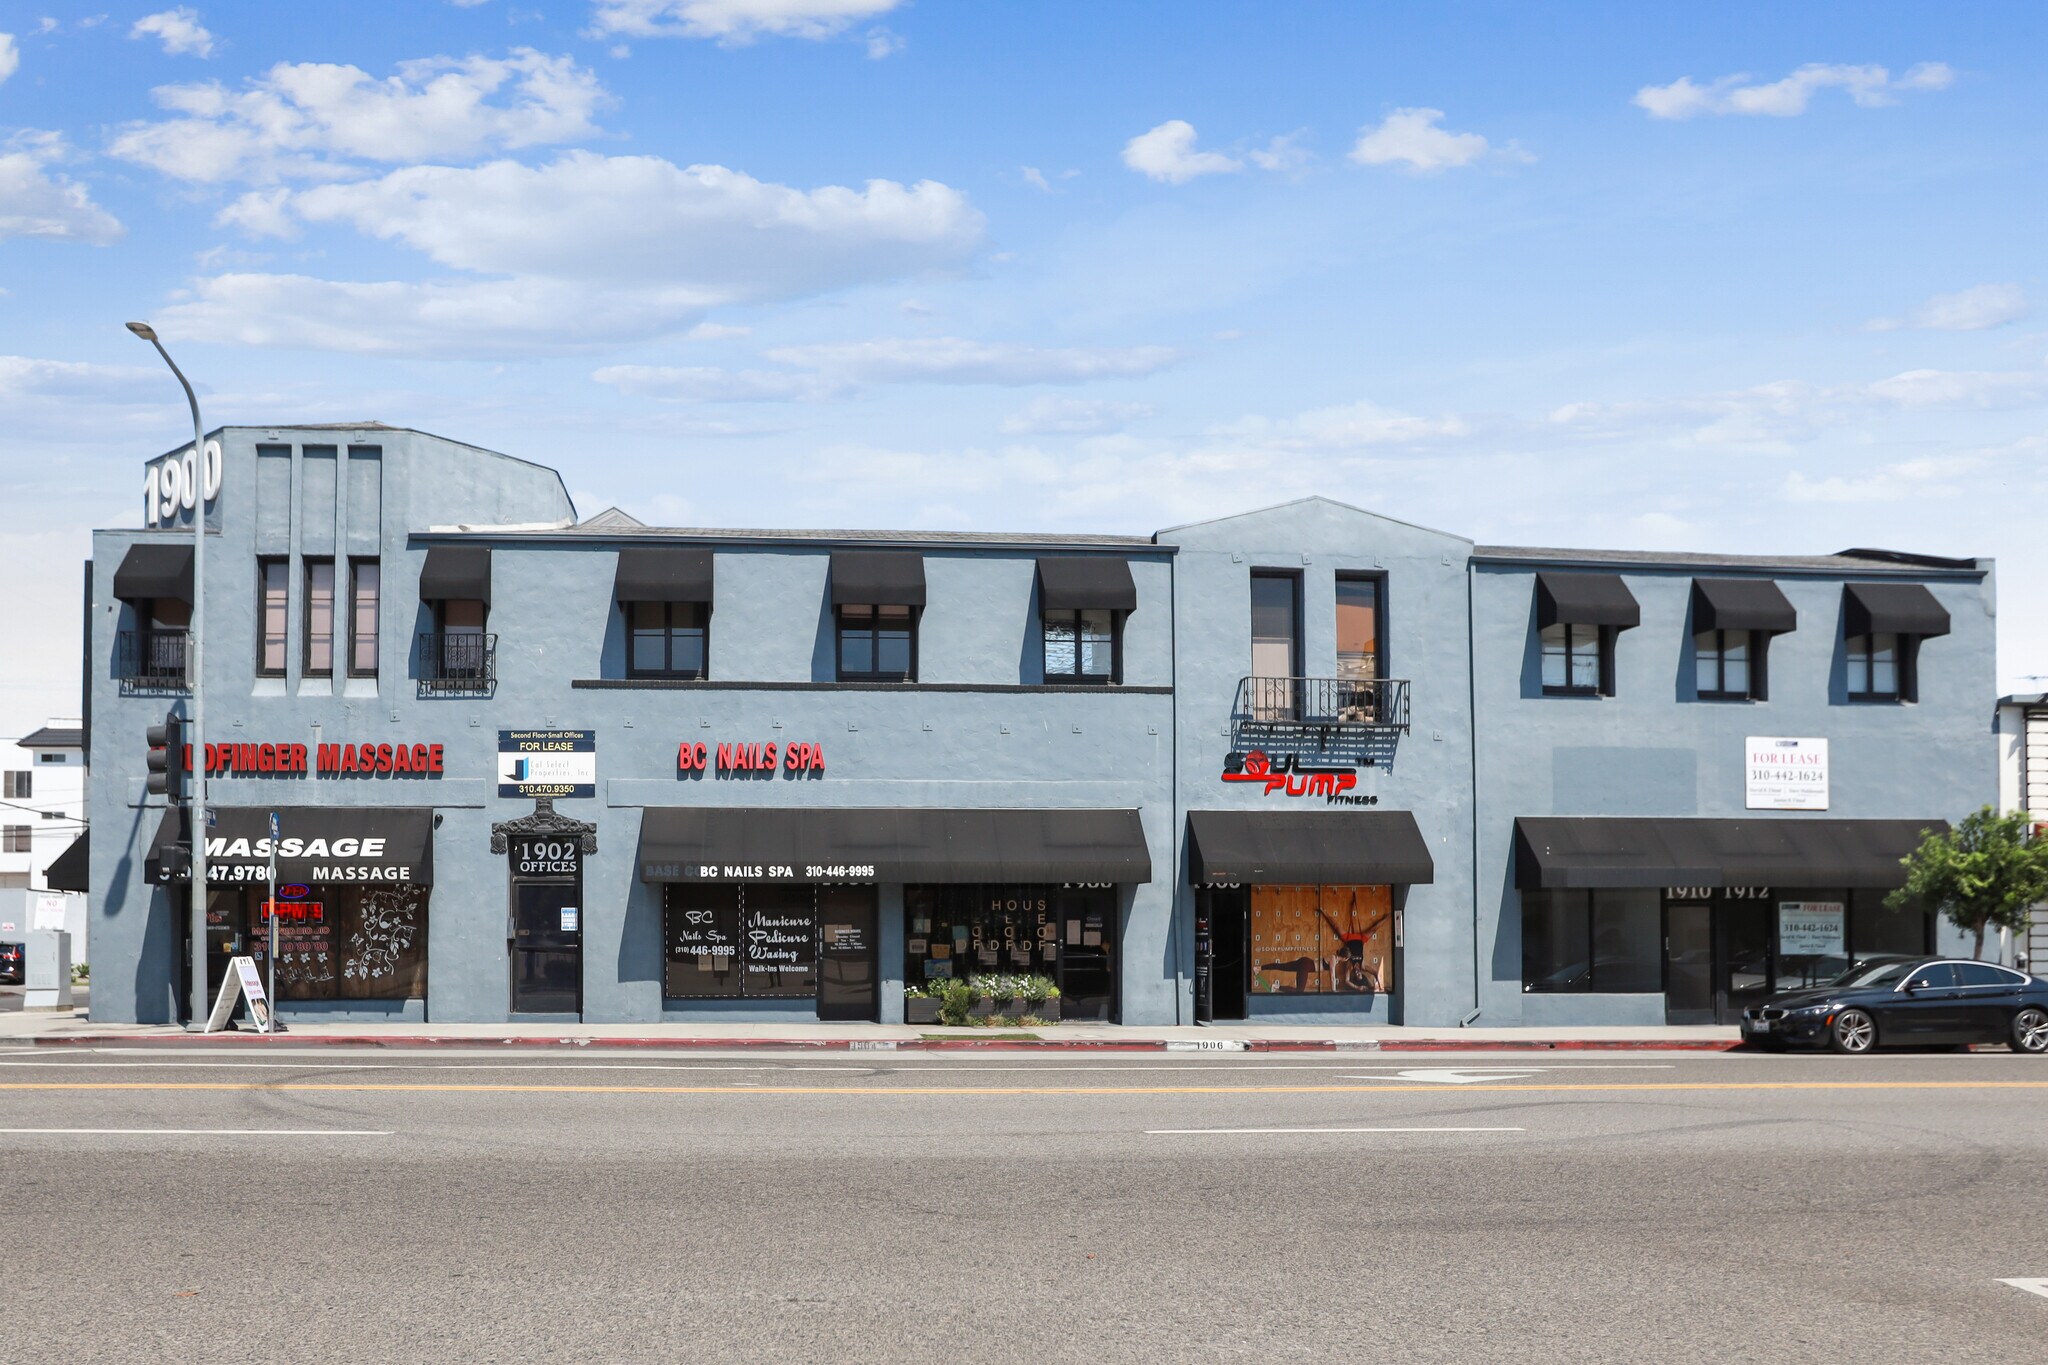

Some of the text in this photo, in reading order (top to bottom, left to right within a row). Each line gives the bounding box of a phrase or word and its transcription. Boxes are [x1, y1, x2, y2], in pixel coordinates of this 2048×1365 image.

[144, 440, 222, 523] 1900
[520, 742, 574, 751] FOR LEASE
[317, 743, 444, 772] MASSAGE
[679, 742, 825, 770] BC NAILS SPA
[1753, 753, 1822, 765] FOR LEASE
[546, 760, 569, 768] Select
[1221, 763, 1357, 796] PUMP
[1752, 770, 1823, 781] 310-442-1624
[519, 784, 575, 793] 310.470.9350
[1326, 795, 1378, 805] FITNESS
[521, 843, 575, 860] 1902
[312, 866, 410, 880] MASSAGE
[520, 861, 577, 872] OFFICES
[700, 866, 718, 877] BC
[724, 866, 763, 878] NAILS
[768, 866, 794, 878] SPA
[805, 865, 875, 877] 310-446-9995
[685, 910, 714, 925] BC
[748, 911, 812, 928] Manicure
[679, 930, 727, 943] Nails Spa
[748, 927, 809, 945] Pedicure
[690, 945, 735, 955] 446-9995
[748, 945, 798, 962] Waxing
[1197, 1041, 1224, 1049] 1906
